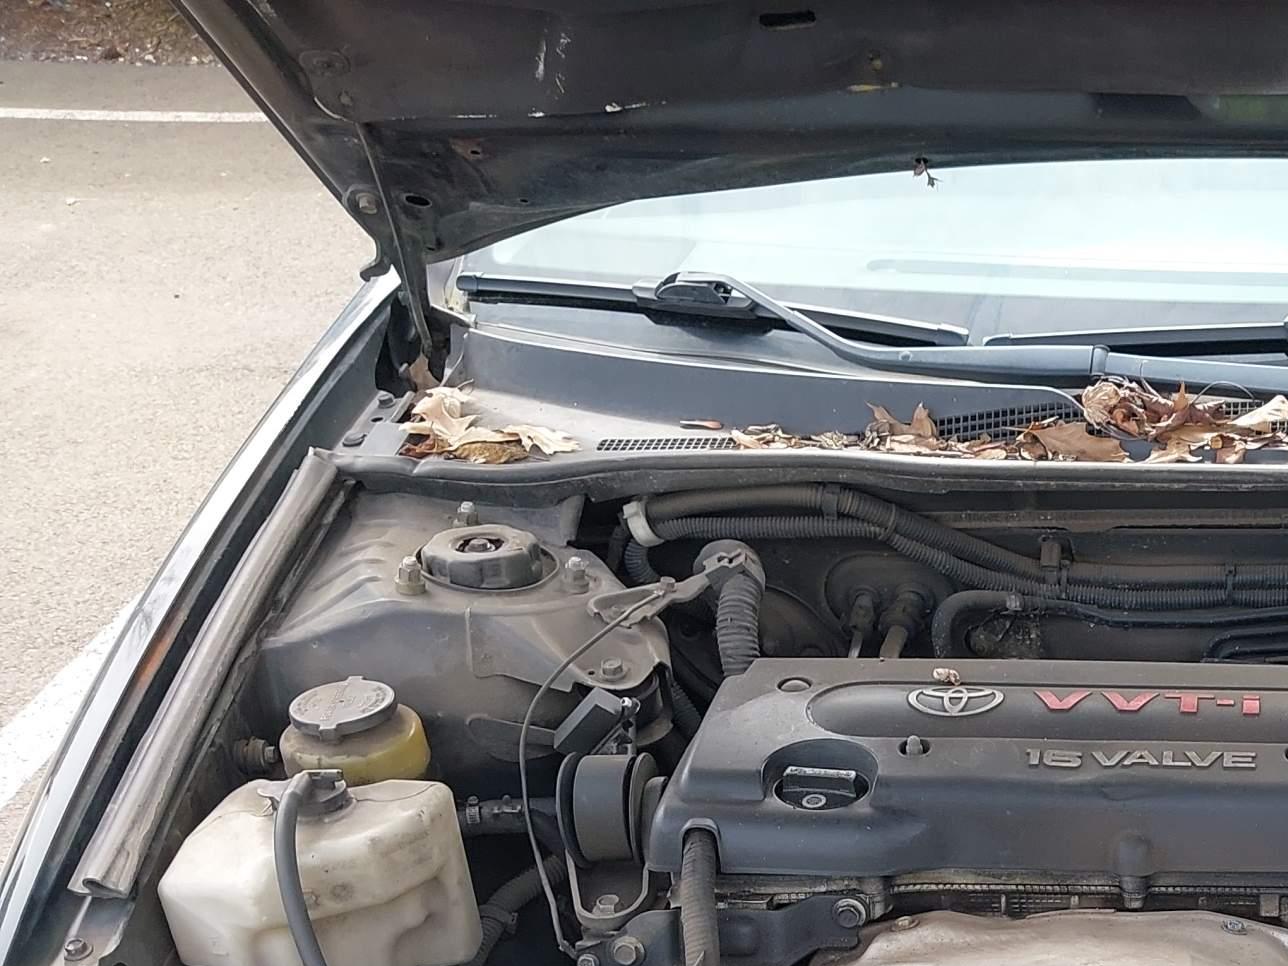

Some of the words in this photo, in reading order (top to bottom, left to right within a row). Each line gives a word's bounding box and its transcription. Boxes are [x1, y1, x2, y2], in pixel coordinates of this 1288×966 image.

[1033, 690, 1260, 716] VVT-i
[1025, 748, 1082, 768] 16
[1091, 750, 1257, 768] VALVE
